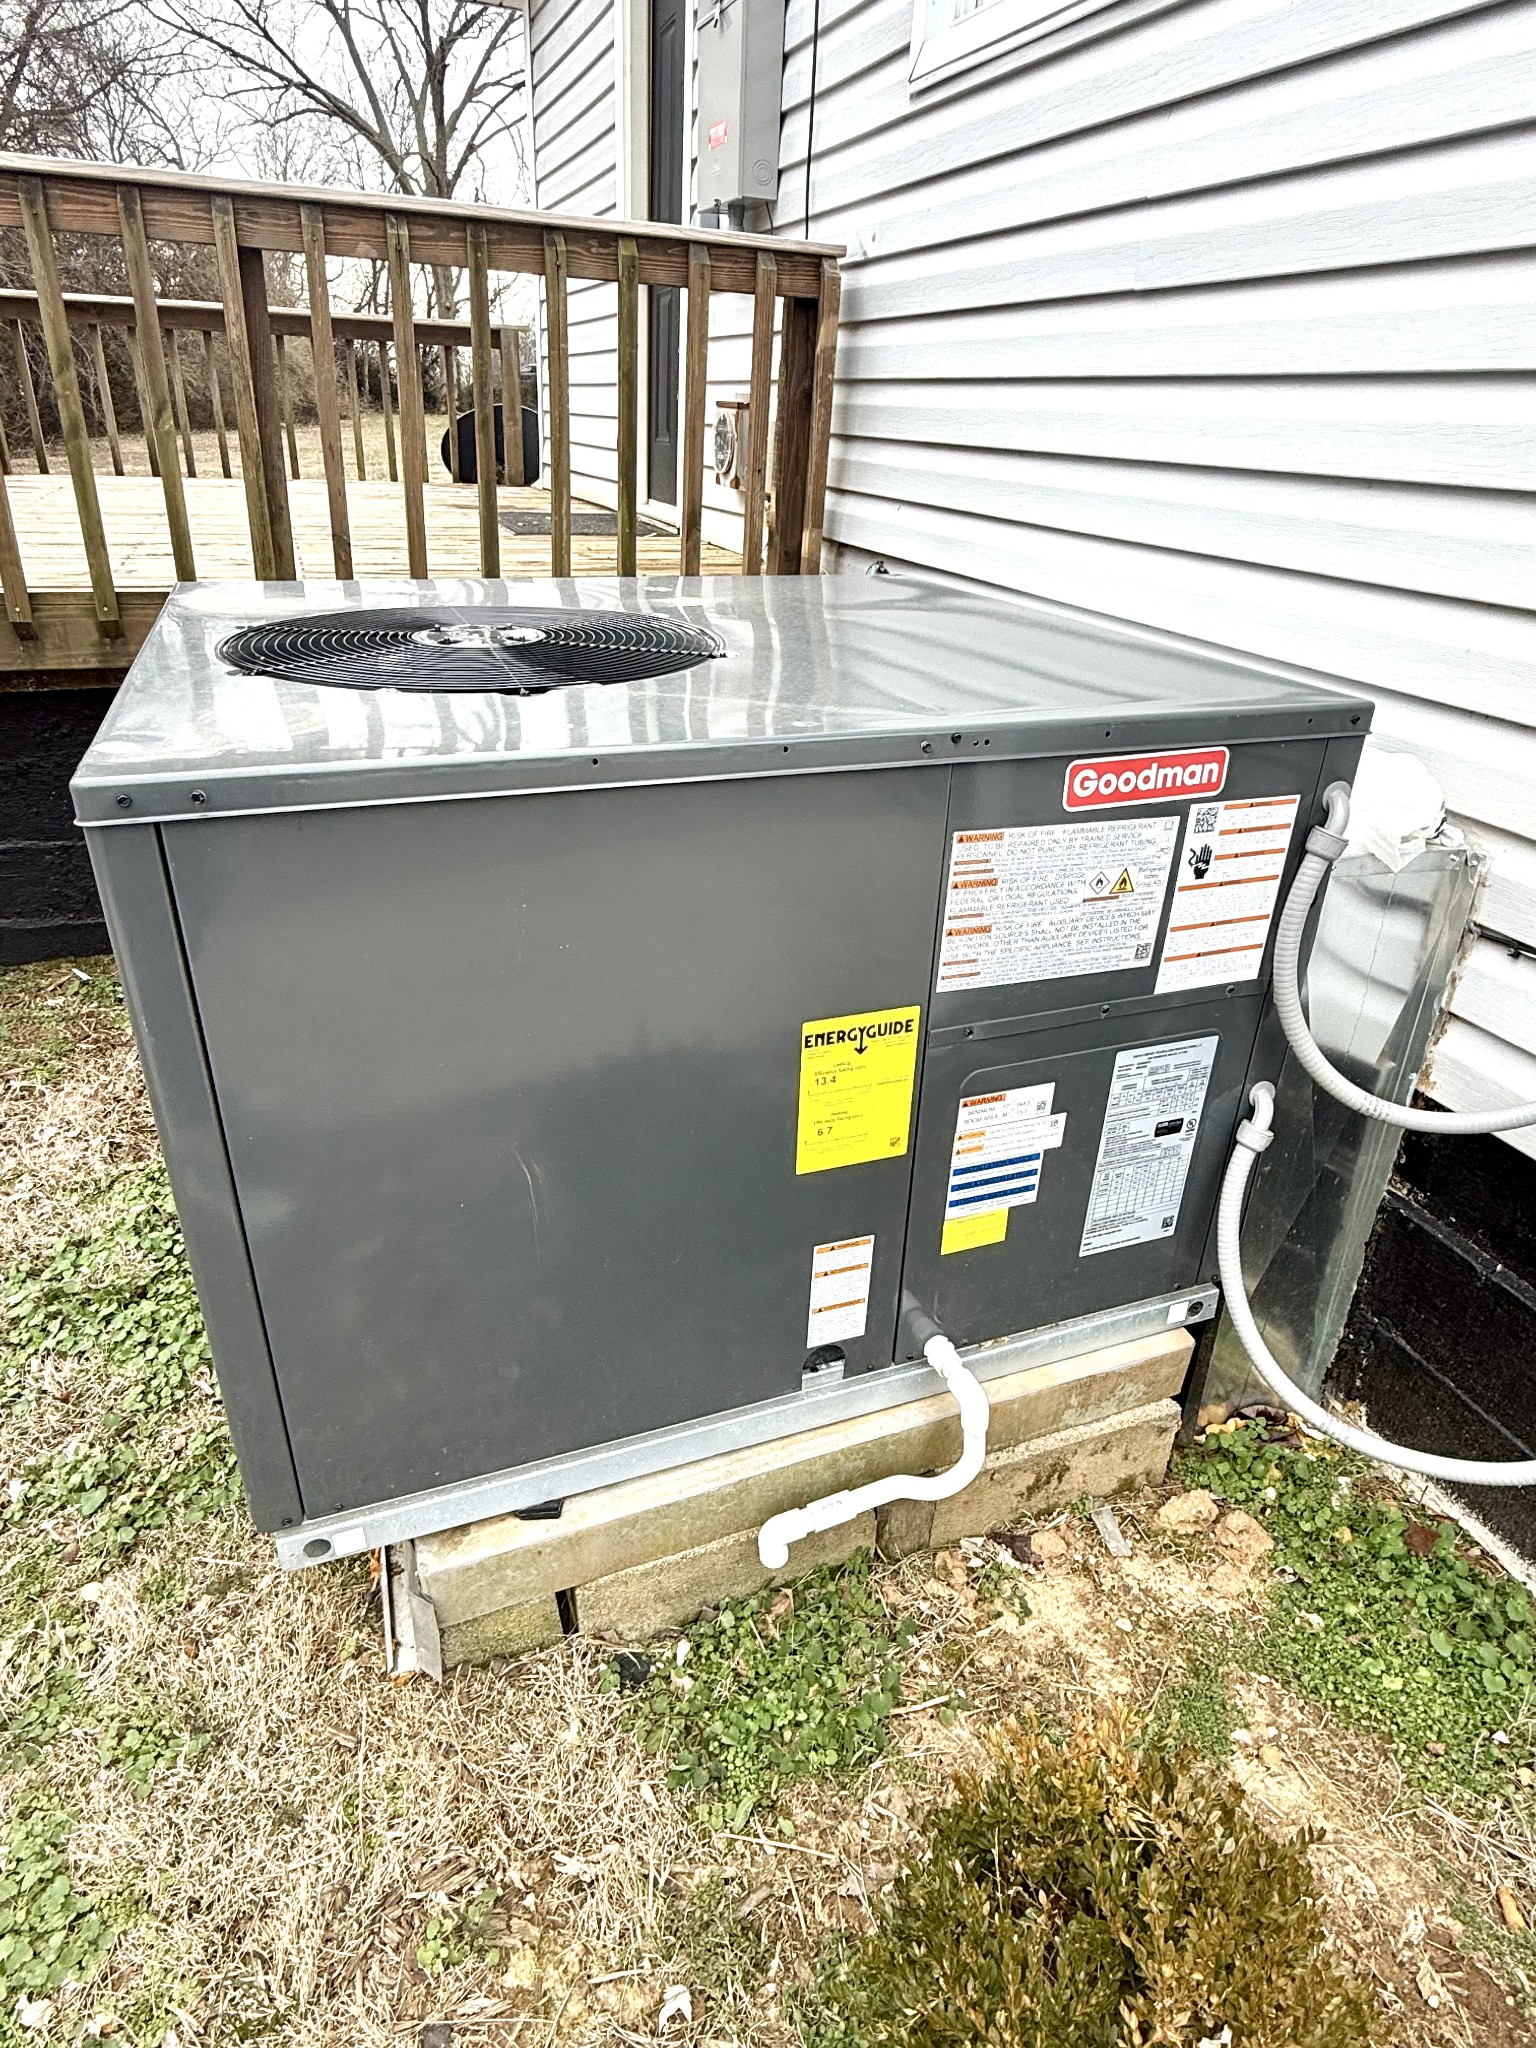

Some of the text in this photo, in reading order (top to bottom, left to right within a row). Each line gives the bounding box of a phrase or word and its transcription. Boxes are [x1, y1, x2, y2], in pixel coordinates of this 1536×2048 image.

[1073, 762, 1220, 798] Goodman
[966, 833, 1003, 842] WARNING
[1009, 831, 1026, 839] RISK
[1027, 830, 1038, 838] OF
[1107, 822, 1157, 832] REFRIGERANT
[1008, 840, 1046, 848] REPAIRED
[960, 878, 997, 888] WARNING
[1001, 876, 1019, 885] RISK
[1020, 875, 1030, 883] OF
[1001, 893, 1025, 901] LOCAL
[996, 900, 1048, 910] REFRIGERANT
[955, 926, 991, 936] WARNING
[1014, 922, 1024, 930] OF
[804, 1019, 915, 1049] ENERGYGUIDE
[815, 1075, 837, 1087] 13.4
[970, 1094, 1003, 1106] WARNING
